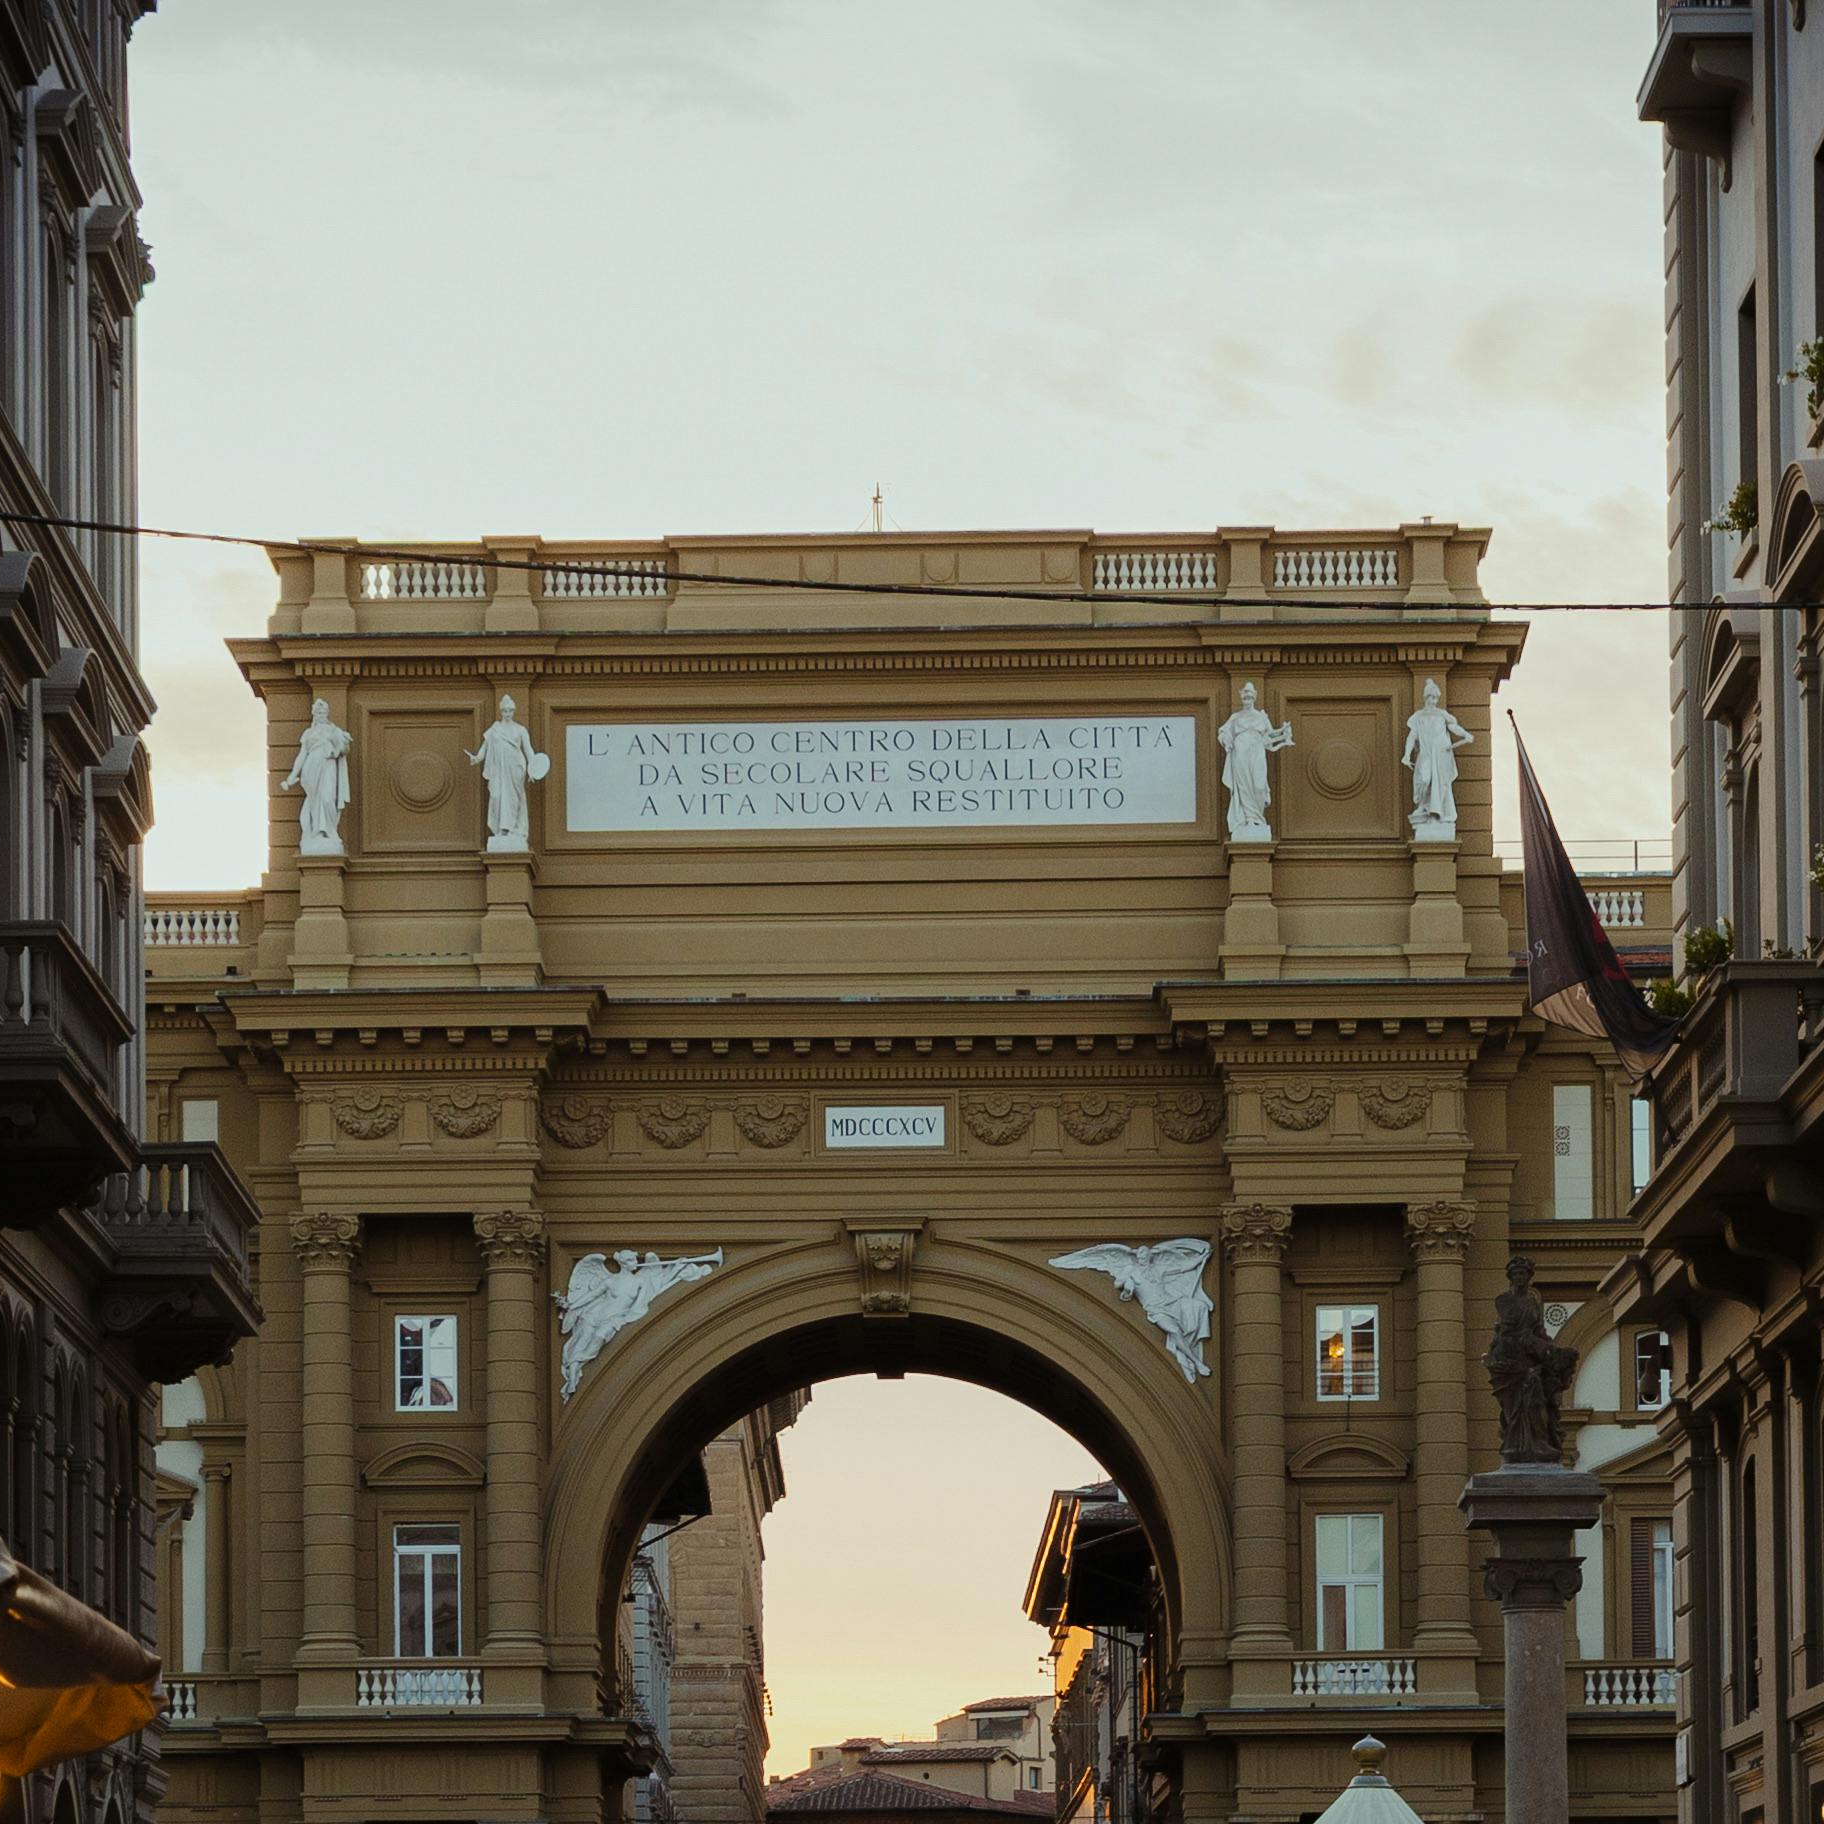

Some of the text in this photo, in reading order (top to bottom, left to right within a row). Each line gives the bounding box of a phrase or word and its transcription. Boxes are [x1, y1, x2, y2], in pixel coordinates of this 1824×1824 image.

[627, 732, 755, 755] ANTICO
[771, 729, 915, 753] CENTRO
[932, 728, 1051, 751] DELLA
[639, 757, 1124, 786] DA SECOLARE SQUALLORE
[640, 788, 1125, 816] A VITA NUOVA RESTITUITO
[831, 1117, 936, 1137] MDCCCXCV
